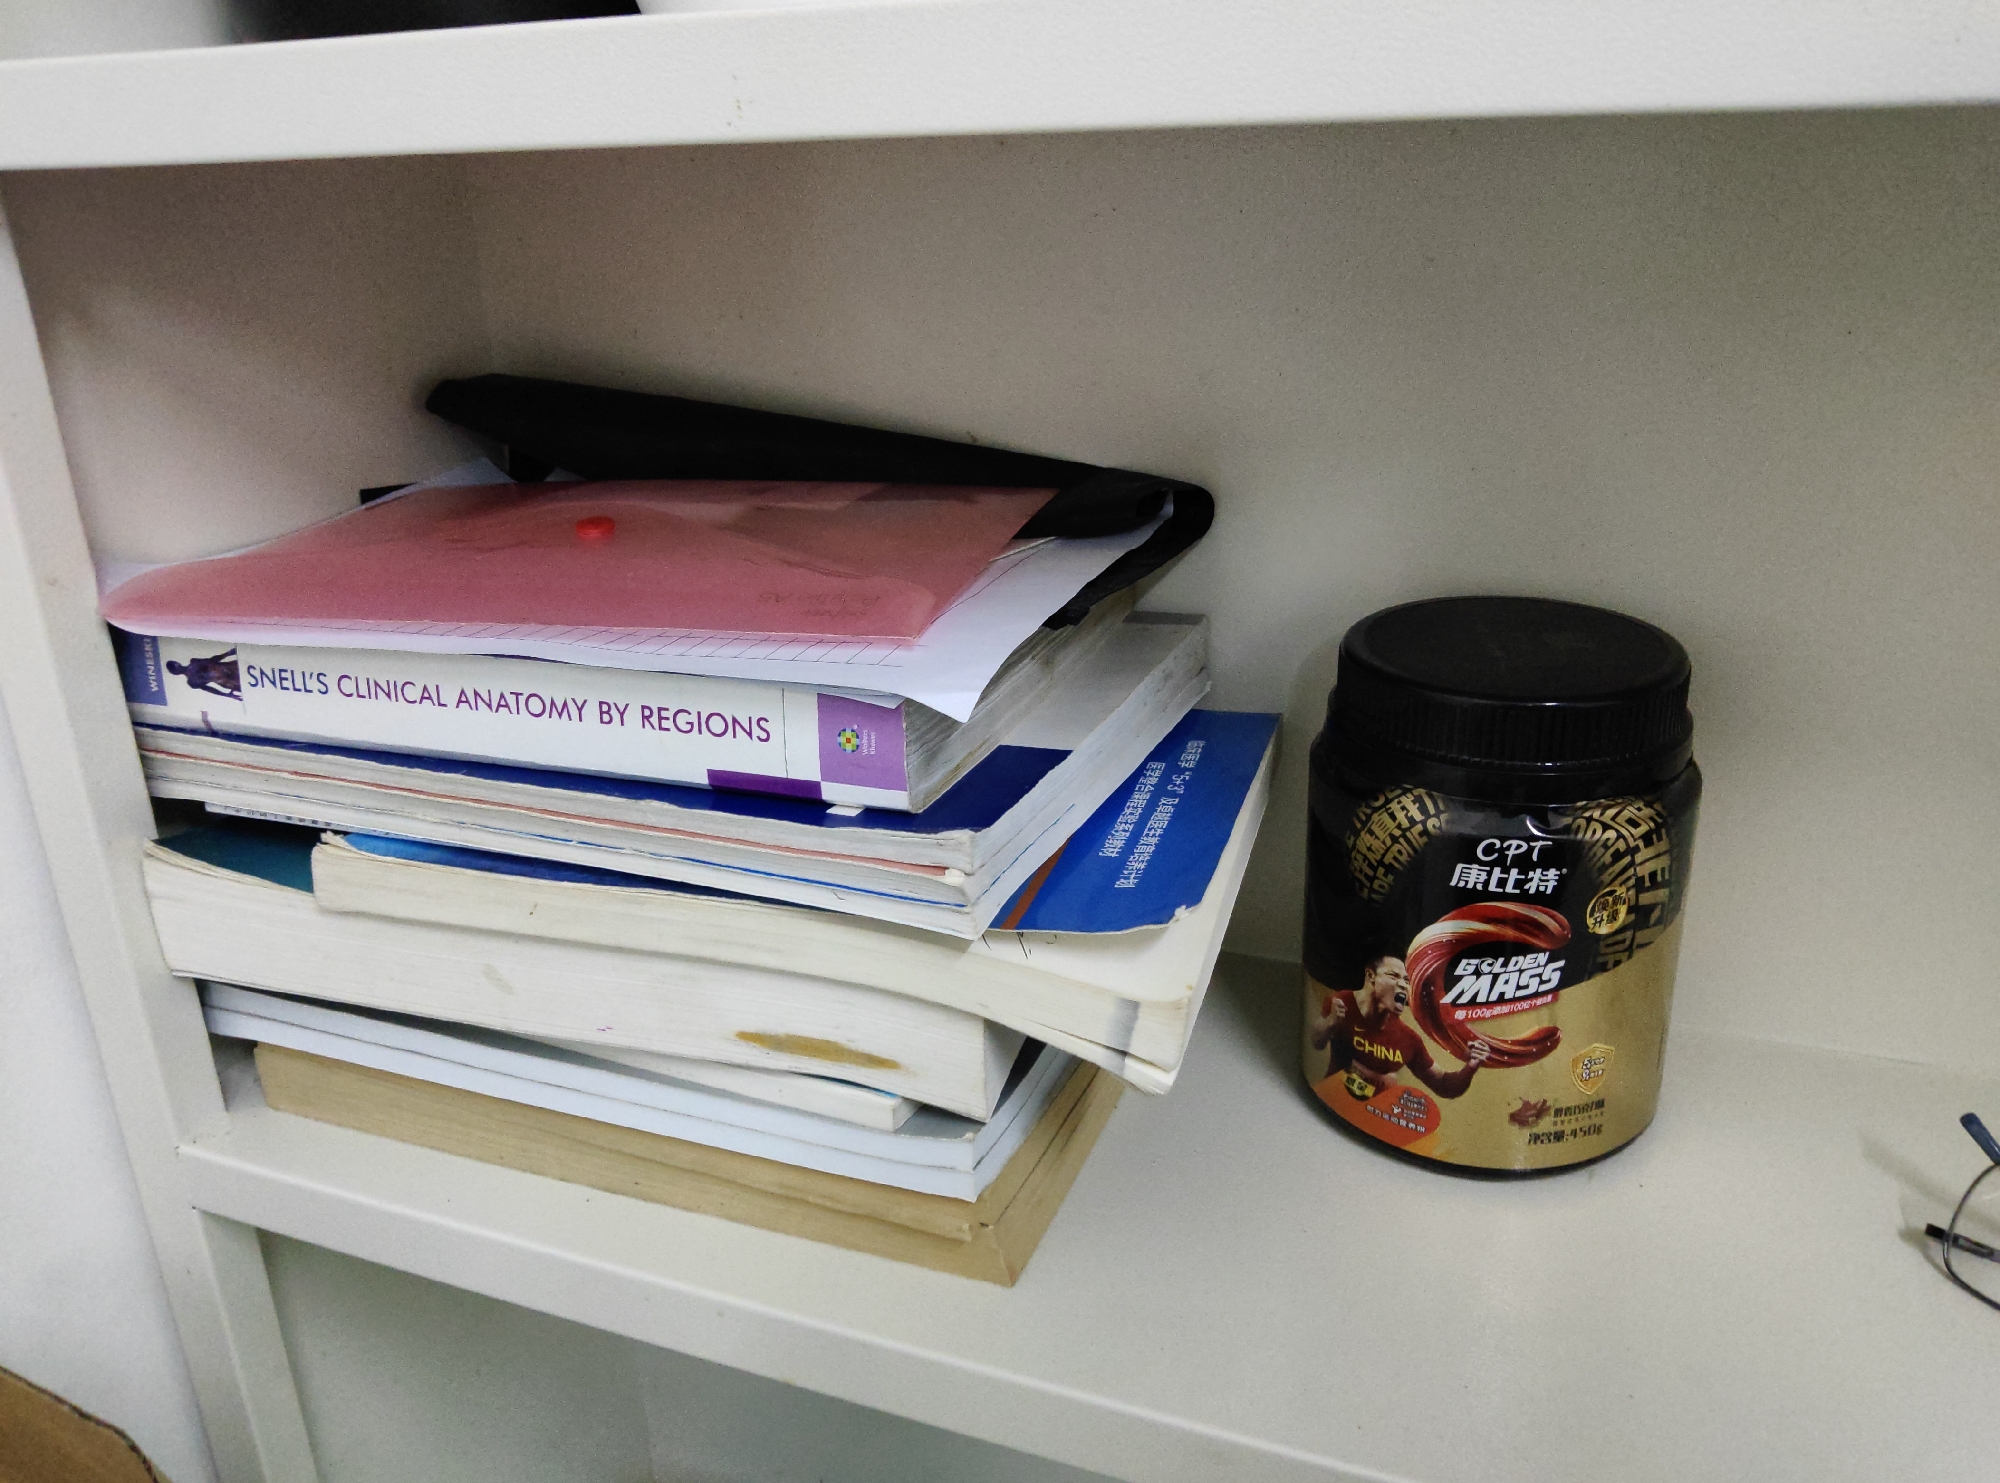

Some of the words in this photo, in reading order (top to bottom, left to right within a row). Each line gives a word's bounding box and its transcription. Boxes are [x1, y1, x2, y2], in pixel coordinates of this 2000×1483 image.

[246, 664, 330, 695] SNELL'S
[336, 673, 449, 709] CLINICAL
[455, 687, 588, 724] ANATOMY
[598, 700, 630, 728] BY
[640, 704, 772, 744] REGIONS
[1476, 838, 1554, 866] CPT
[1449, 863, 1561, 894] 康比特
[1453, 951, 1550, 976] GOLDEN
[1439, 960, 1566, 1004] MASS
[1353, 1036, 1404, 1064] CHINA
